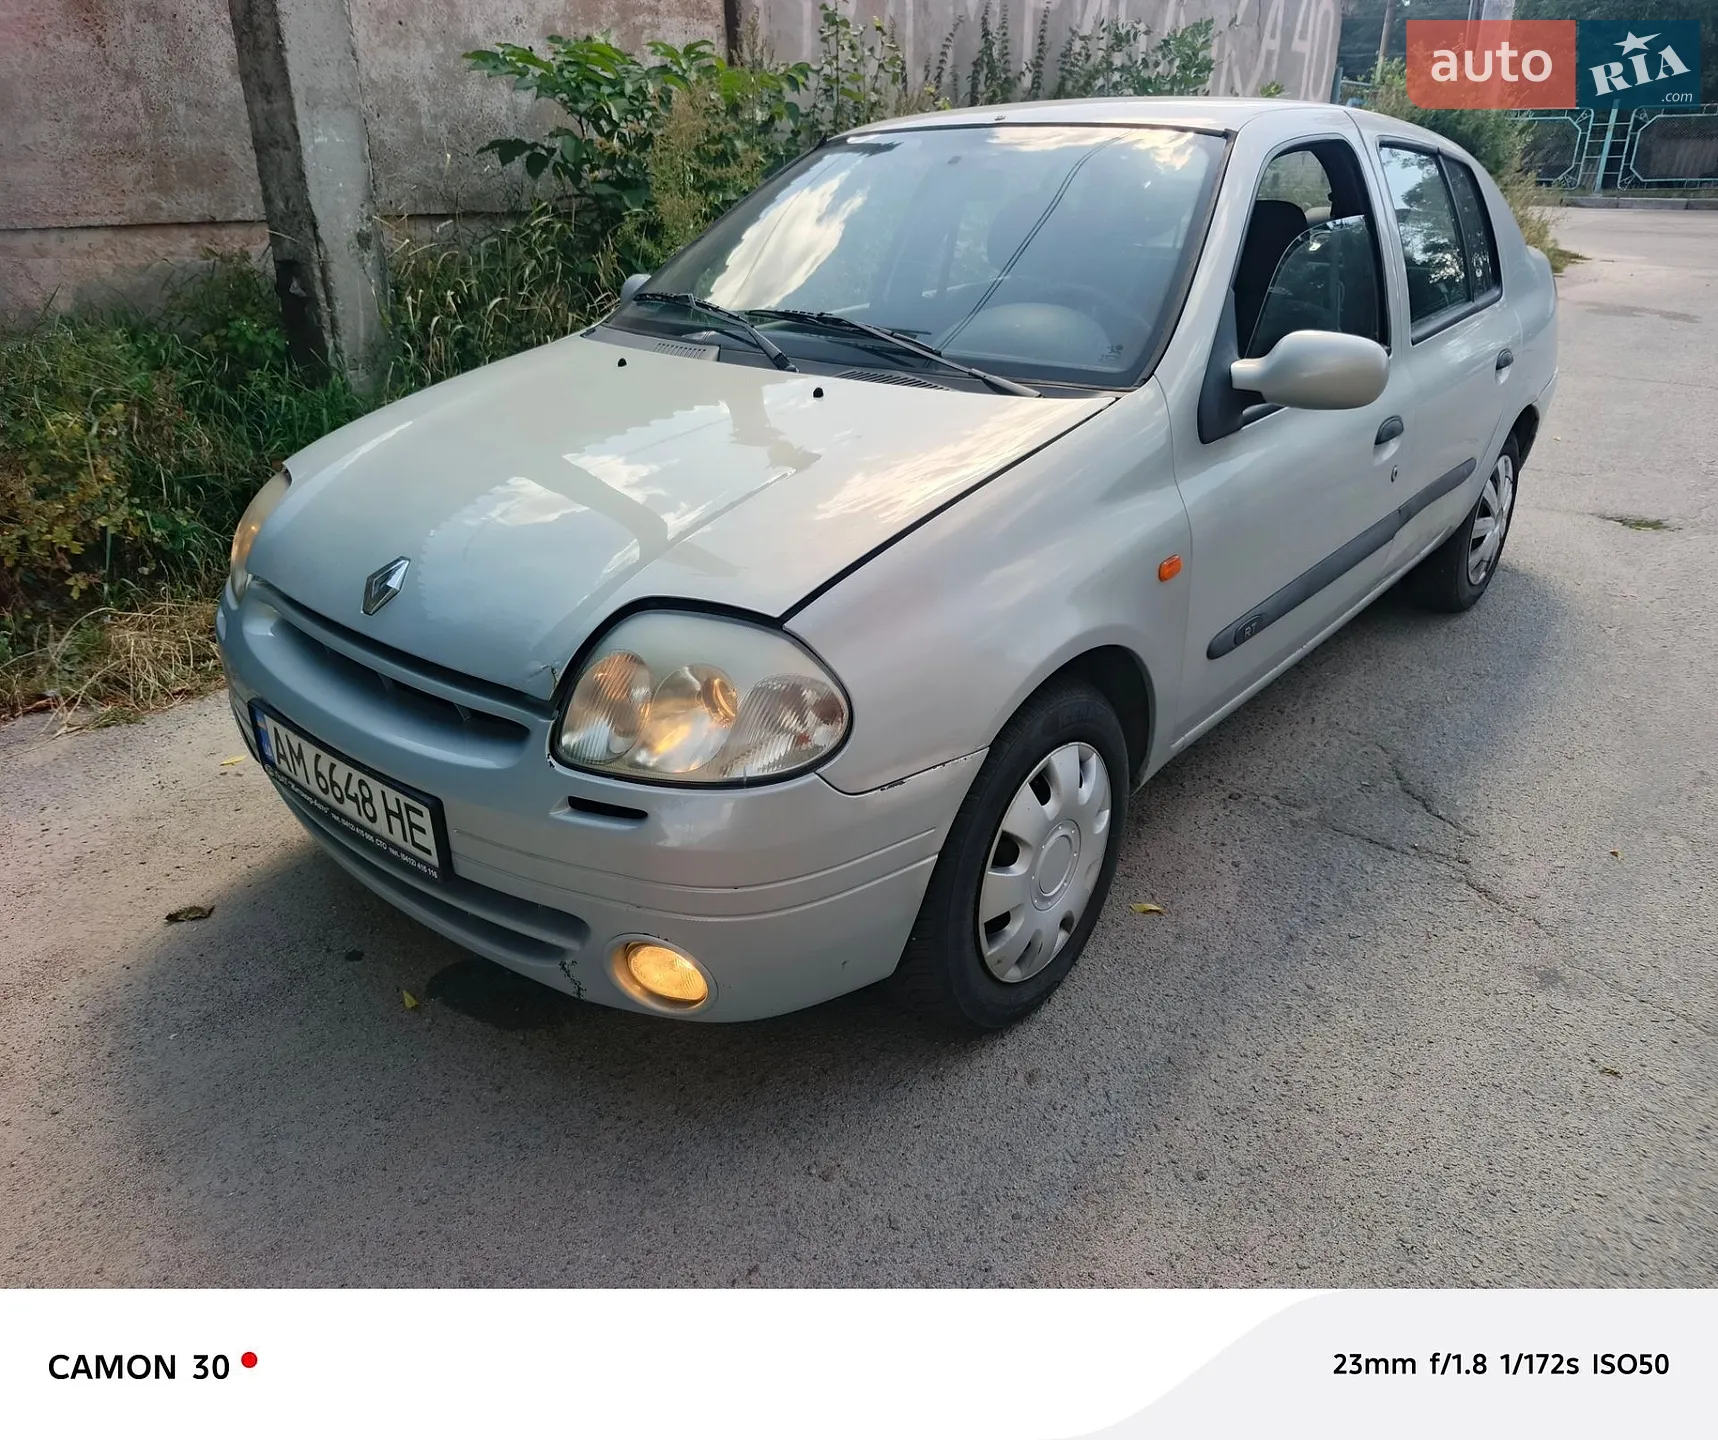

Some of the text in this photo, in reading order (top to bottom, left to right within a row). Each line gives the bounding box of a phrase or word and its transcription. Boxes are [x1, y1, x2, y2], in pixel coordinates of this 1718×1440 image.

[274, 726, 433, 858] AM 6648 HE
